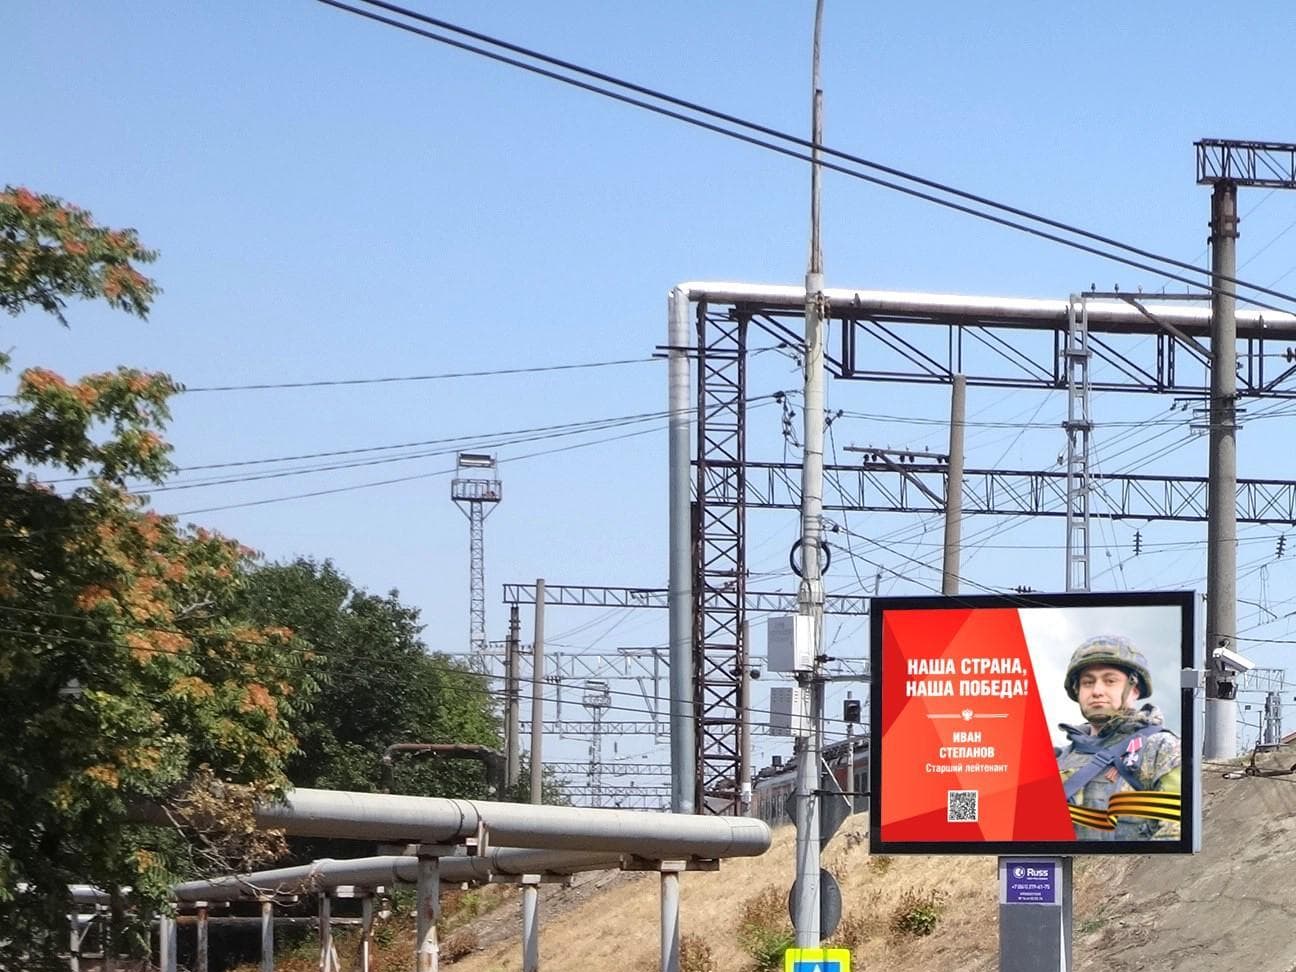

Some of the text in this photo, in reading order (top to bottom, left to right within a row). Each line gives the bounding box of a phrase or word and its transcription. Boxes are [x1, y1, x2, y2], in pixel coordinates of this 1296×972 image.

[907, 658, 1027, 676] НАША СТРАНА,
[906, 679, 1029, 699] НАША ПОБЕДА!
[952, 731, 982, 743] ИВАН
[939, 746, 995, 759] СТЕПАНОВ
[925, 763, 1009, 774] Старший лейтенант
[1026, 867, 1049, 877] Russ
